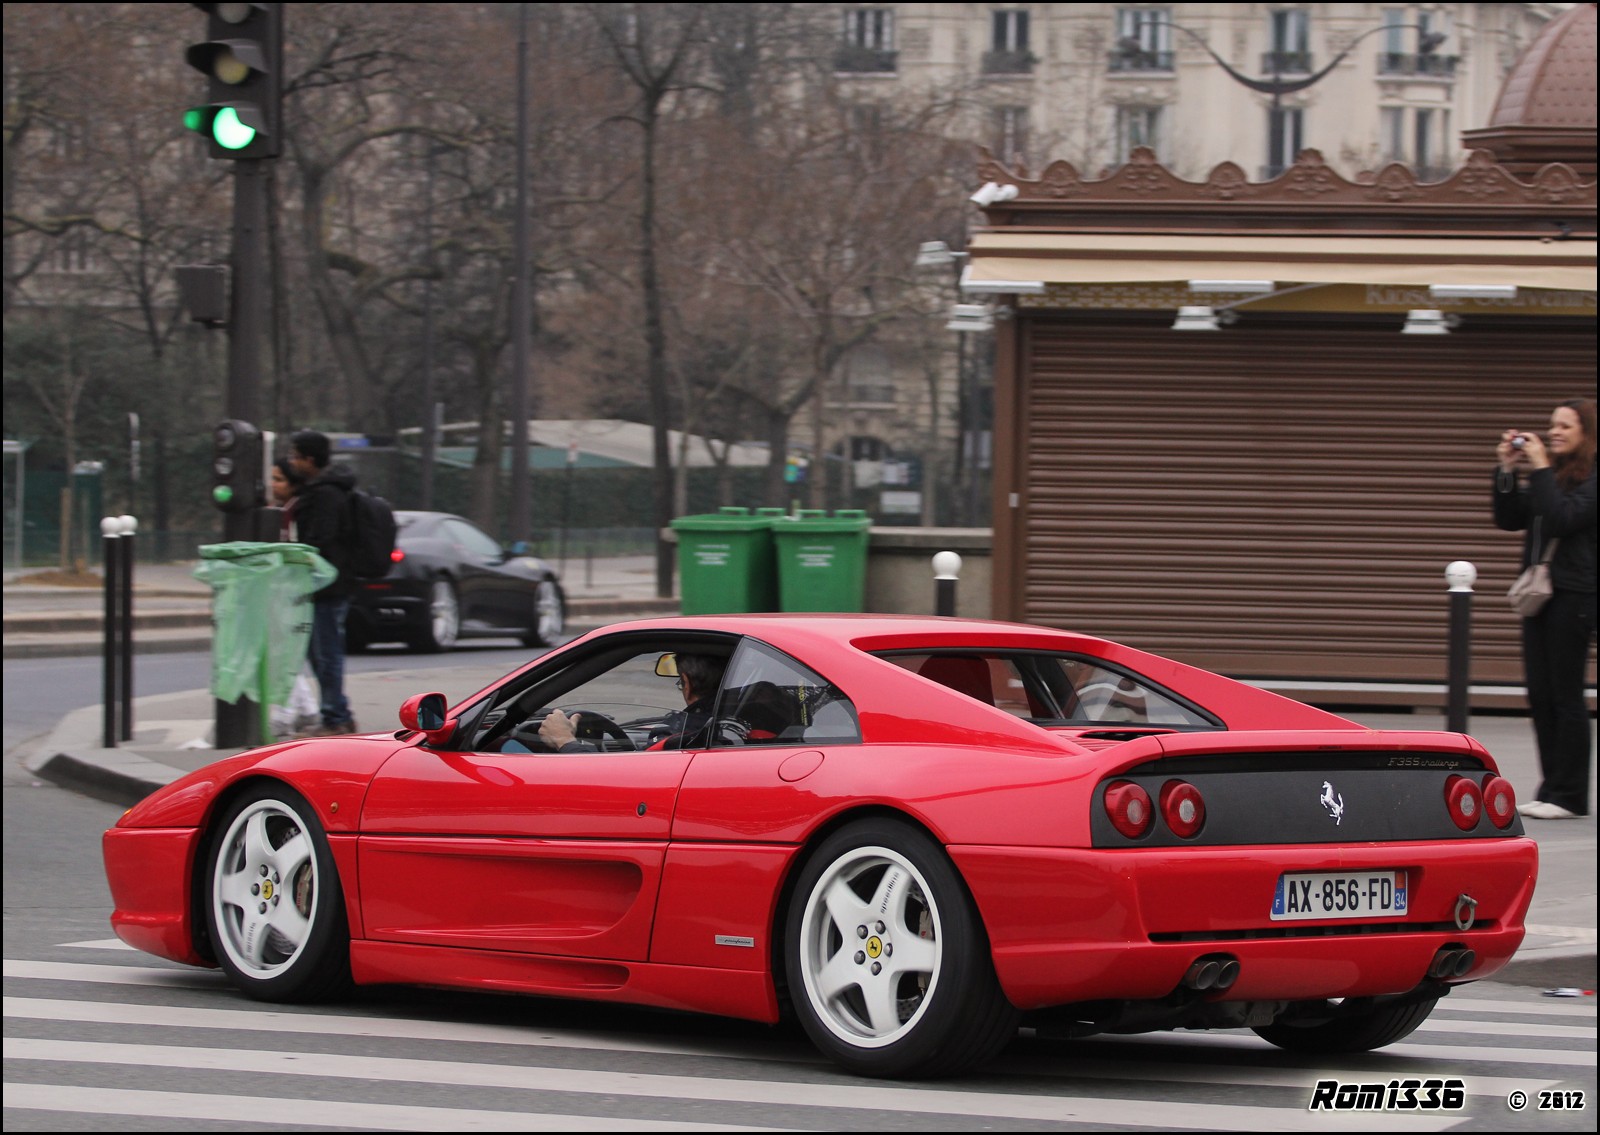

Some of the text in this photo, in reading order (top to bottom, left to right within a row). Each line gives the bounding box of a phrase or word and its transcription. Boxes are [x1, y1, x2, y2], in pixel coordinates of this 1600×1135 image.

[1387, 757, 1420, 766] F355
[1287, 878, 1392, 913] AX-856-FD
[1395, 892, 1405, 907] 34
[1275, 899, 1280, 909] F
